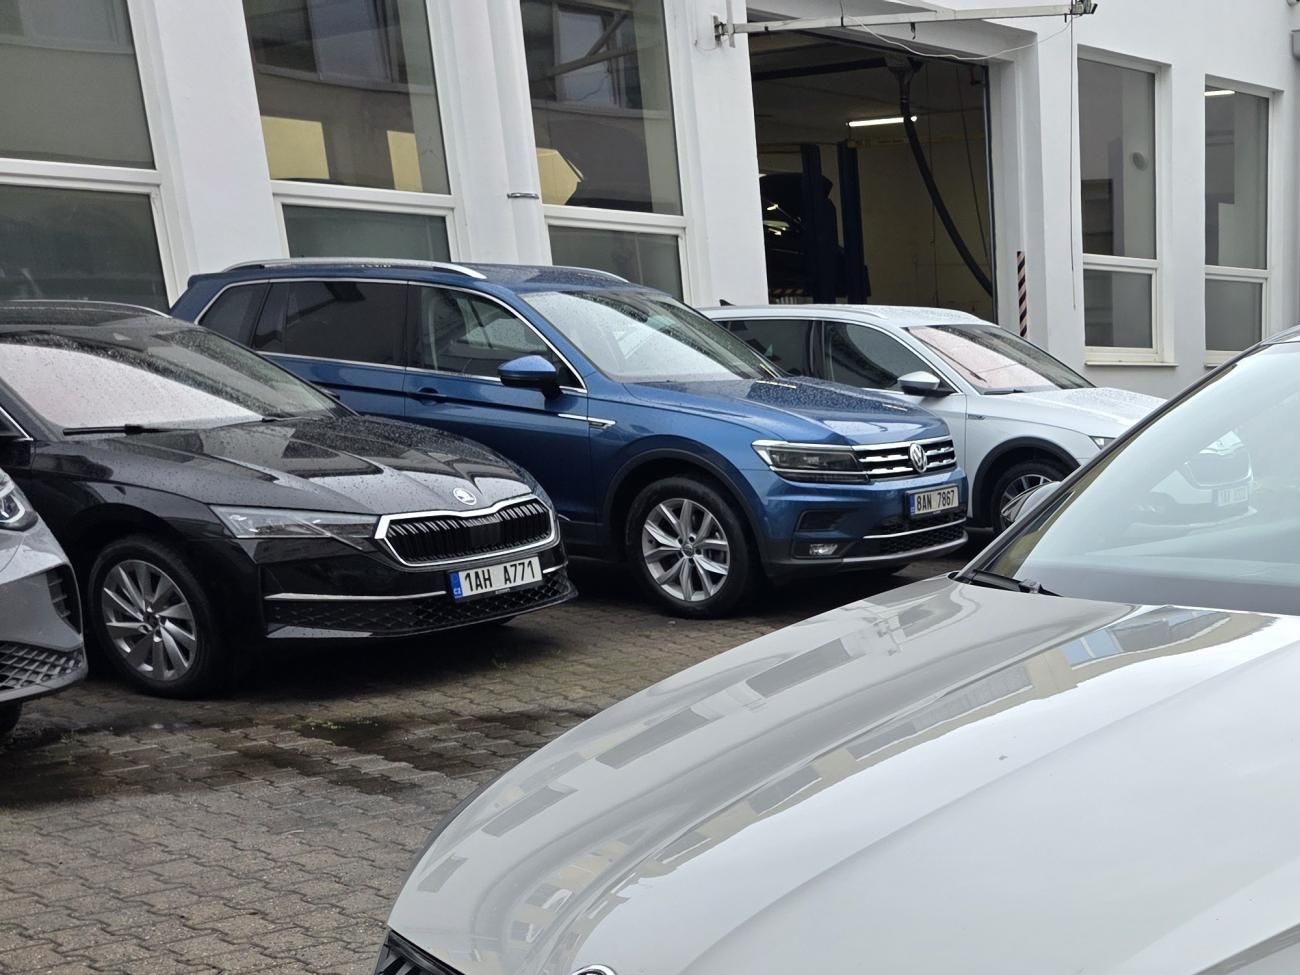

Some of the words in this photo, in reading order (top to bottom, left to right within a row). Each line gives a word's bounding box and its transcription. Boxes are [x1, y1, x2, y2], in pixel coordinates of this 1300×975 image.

[916, 494, 932, 512] 8AN
[937, 489, 955, 509] 7867
[464, 568, 493, 592] 1AH
[503, 560, 535, 585] A771
